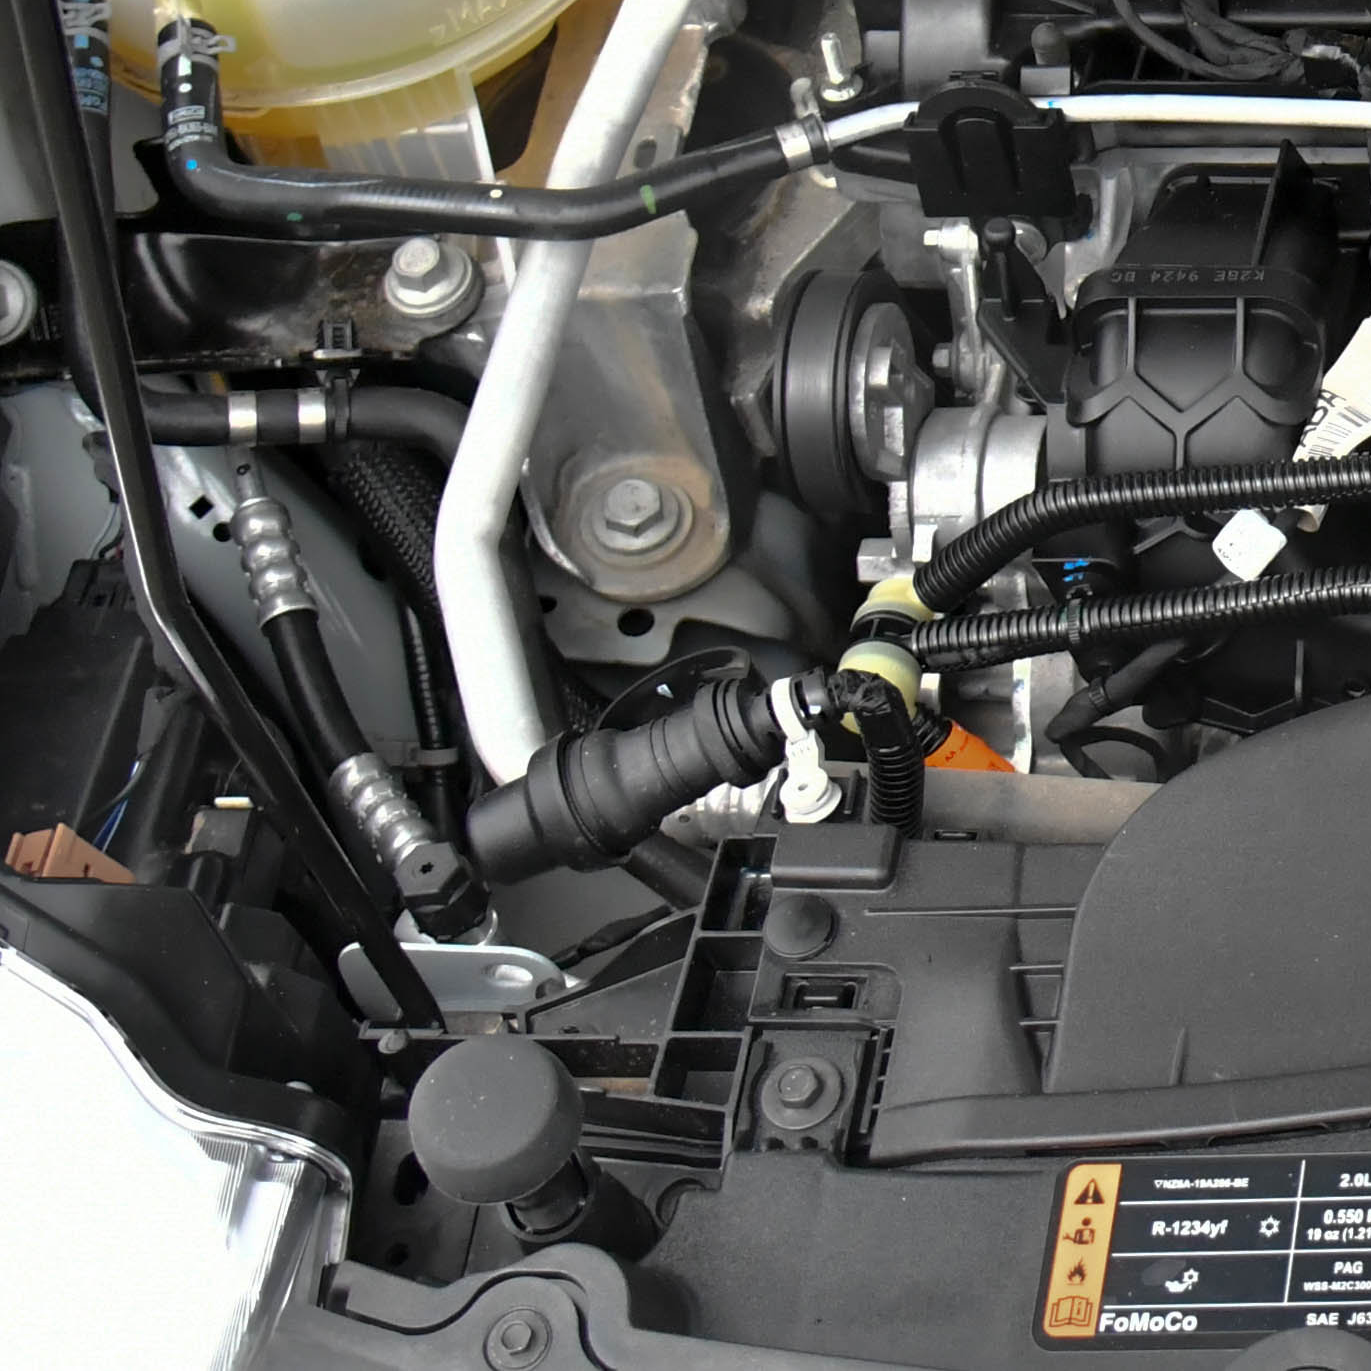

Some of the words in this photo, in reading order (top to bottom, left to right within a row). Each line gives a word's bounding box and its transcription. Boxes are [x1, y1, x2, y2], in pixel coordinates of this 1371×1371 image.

[1151, 269, 1199, 282] 9424
[1323, 1209, 1364, 1224] 0.550
[1151, 1219, 1229, 1239] R-1234yf
[1307, 1229, 1322, 1240] 19
[1342, 1228, 1370, 1242] (1.21
[1333, 1261, 1364, 1274] PAG
[1100, 1312, 1198, 1332] FoMoCo
[1306, 1313, 1339, 1326] SAE
